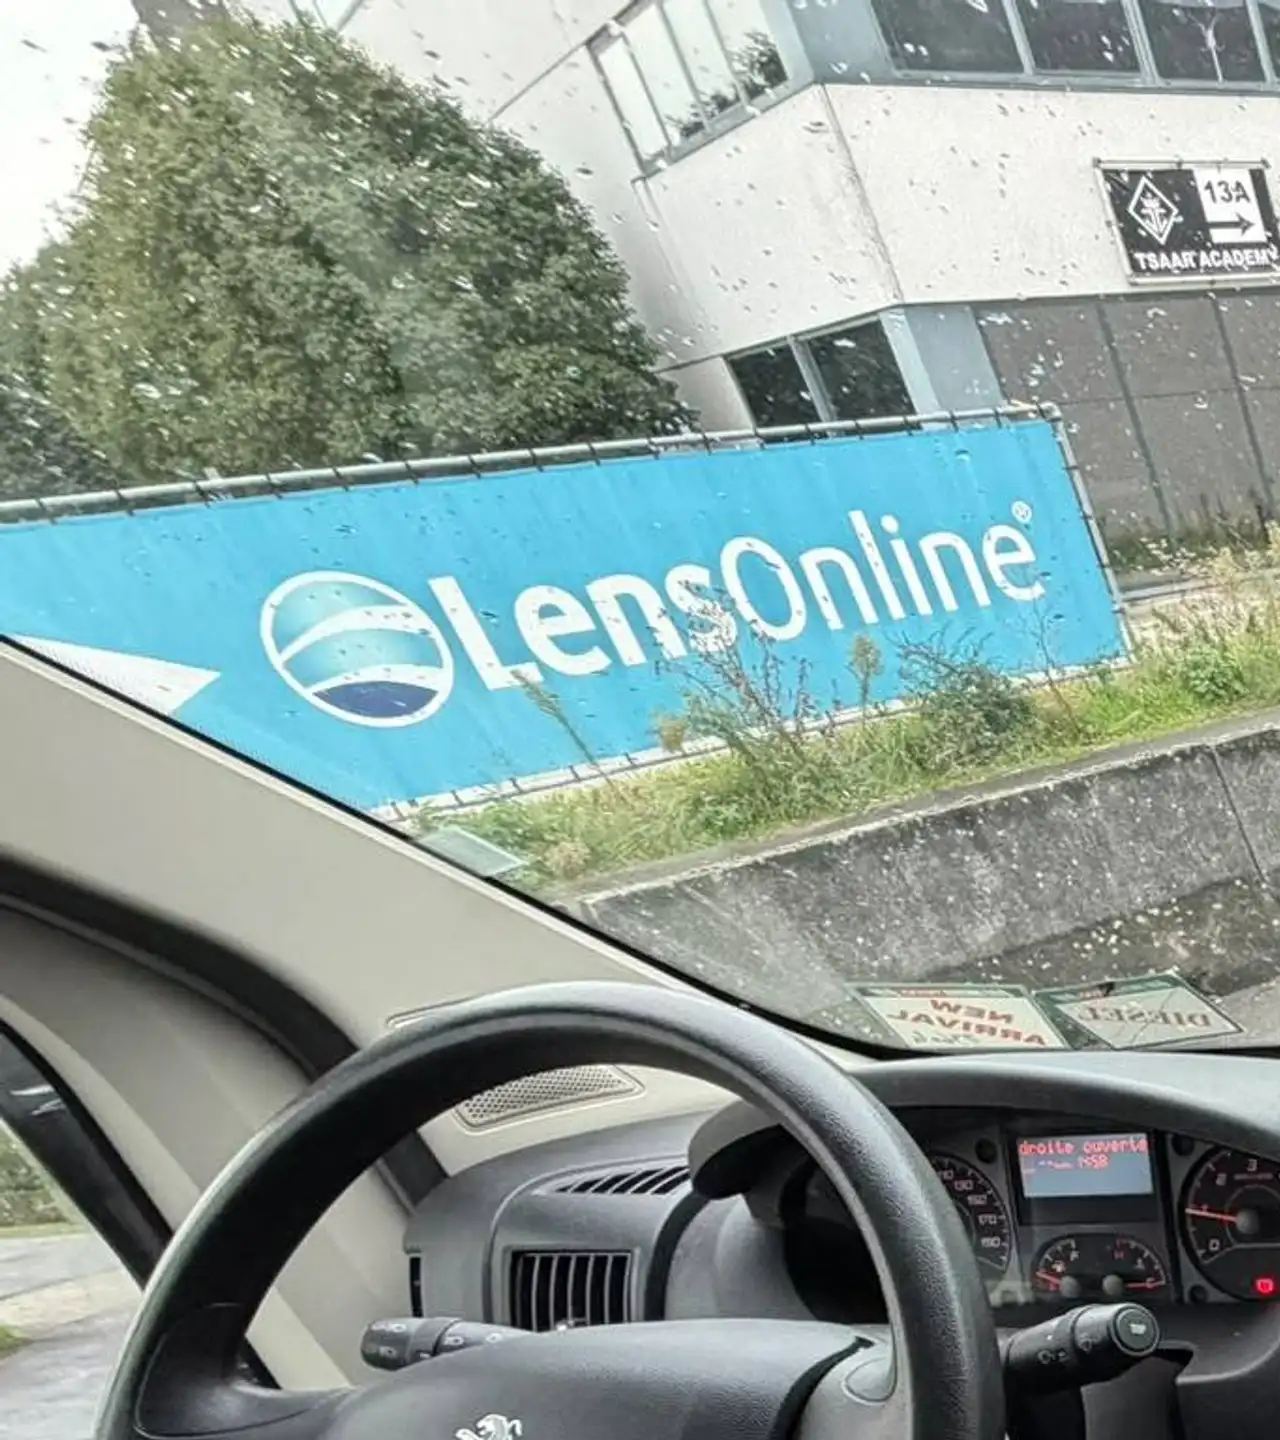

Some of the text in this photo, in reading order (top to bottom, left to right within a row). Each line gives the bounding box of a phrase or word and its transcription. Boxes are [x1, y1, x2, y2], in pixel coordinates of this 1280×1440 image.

[1204, 180, 1251, 204] 13A
[1133, 247, 1279, 271] TSAAR ACADEMY
